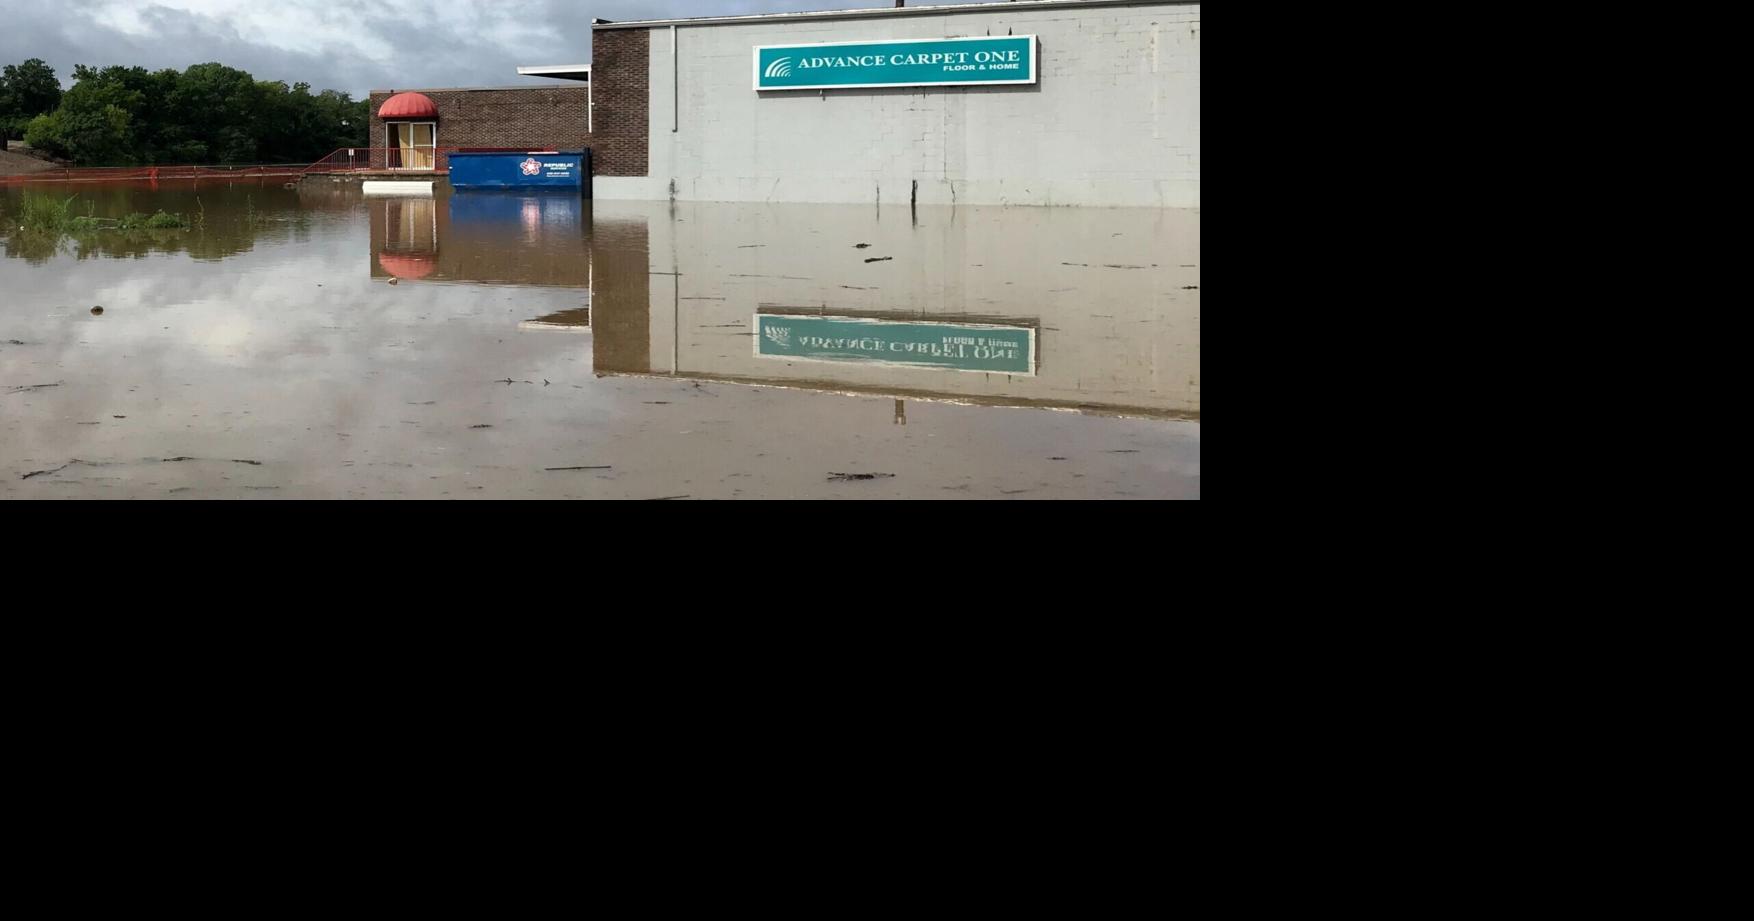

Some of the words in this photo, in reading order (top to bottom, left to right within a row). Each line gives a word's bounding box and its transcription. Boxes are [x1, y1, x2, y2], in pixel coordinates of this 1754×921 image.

[797, 55, 885, 69] ADVANCE
[890, 52, 968, 66] CARPET
[974, 50, 1020, 62] ONE
